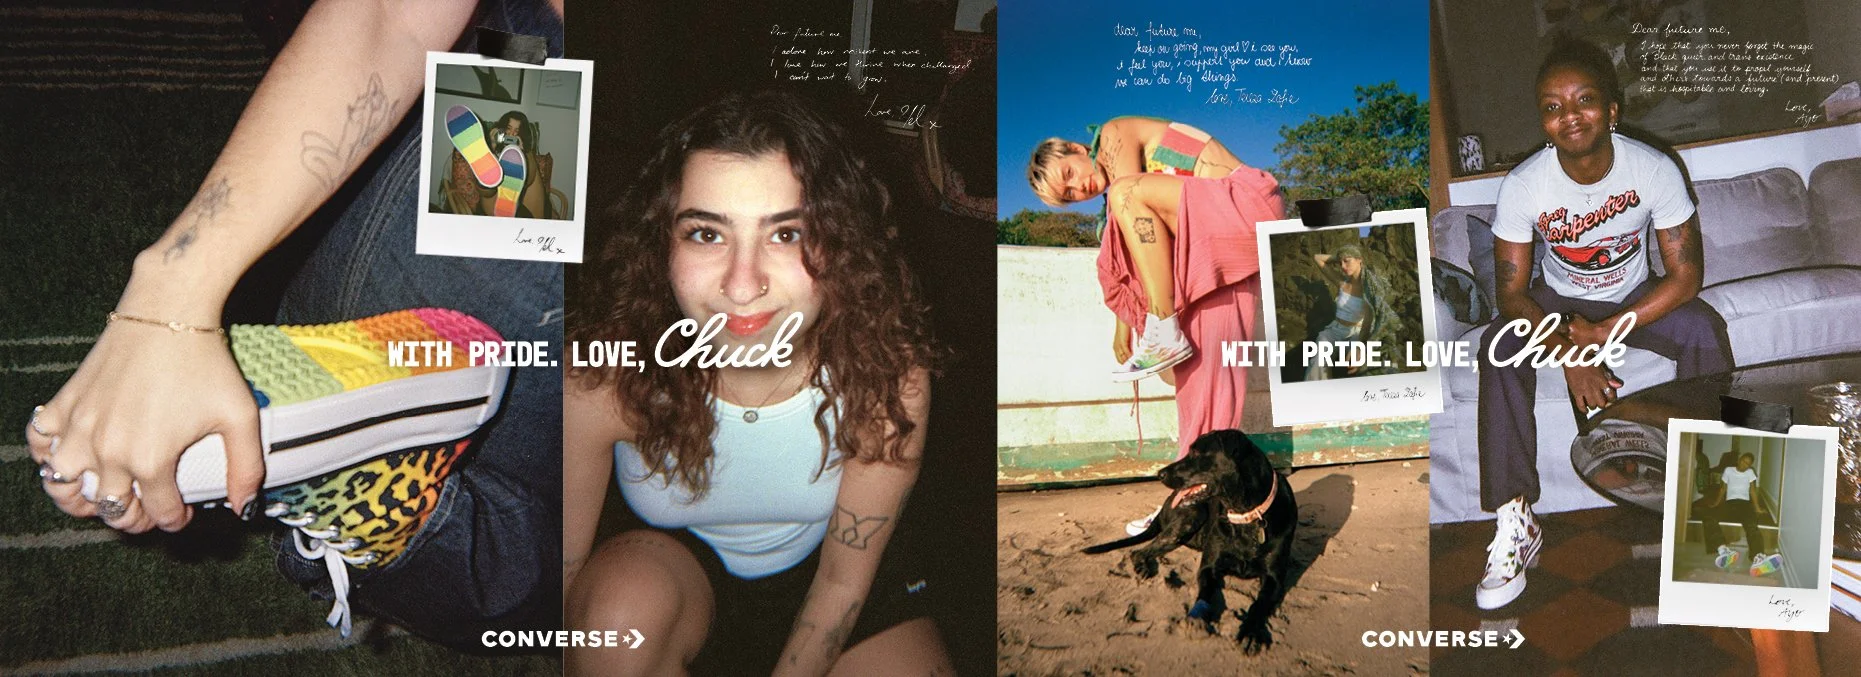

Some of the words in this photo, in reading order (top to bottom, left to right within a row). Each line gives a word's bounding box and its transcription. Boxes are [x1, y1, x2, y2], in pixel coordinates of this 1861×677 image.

[1546, 189, 1640, 244] arpenter
[1567, 272, 1600, 284] MINERAL
[1603, 267, 1627, 281] WELLS
